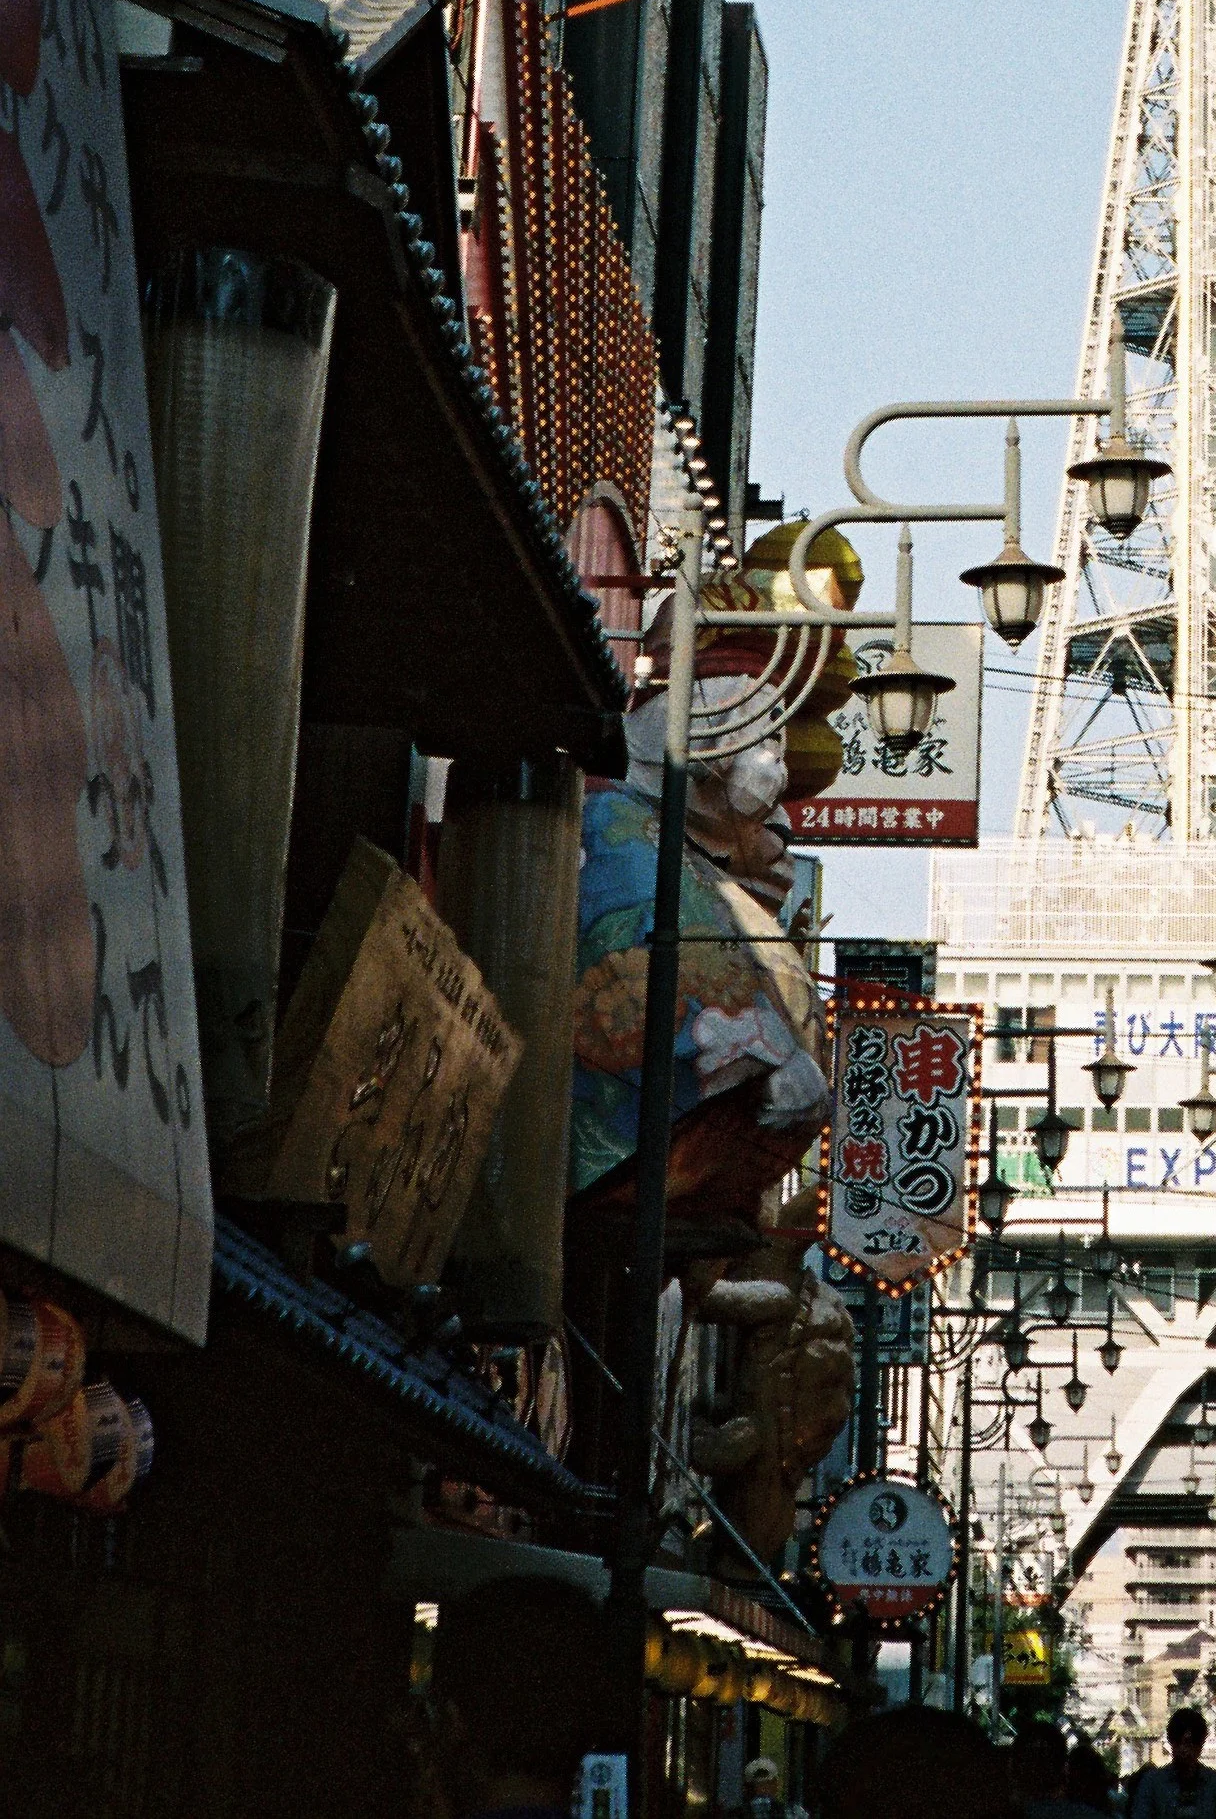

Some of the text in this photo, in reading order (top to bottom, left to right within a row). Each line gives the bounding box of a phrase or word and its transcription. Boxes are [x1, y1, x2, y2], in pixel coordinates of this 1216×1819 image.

[801, 805, 945, 830] 24時間営業中
[841, 1026, 890, 1218] お好み焼き
[894, 1025, 963, 1213] 串かつ
[863, 1229, 921, 1255] エビス
